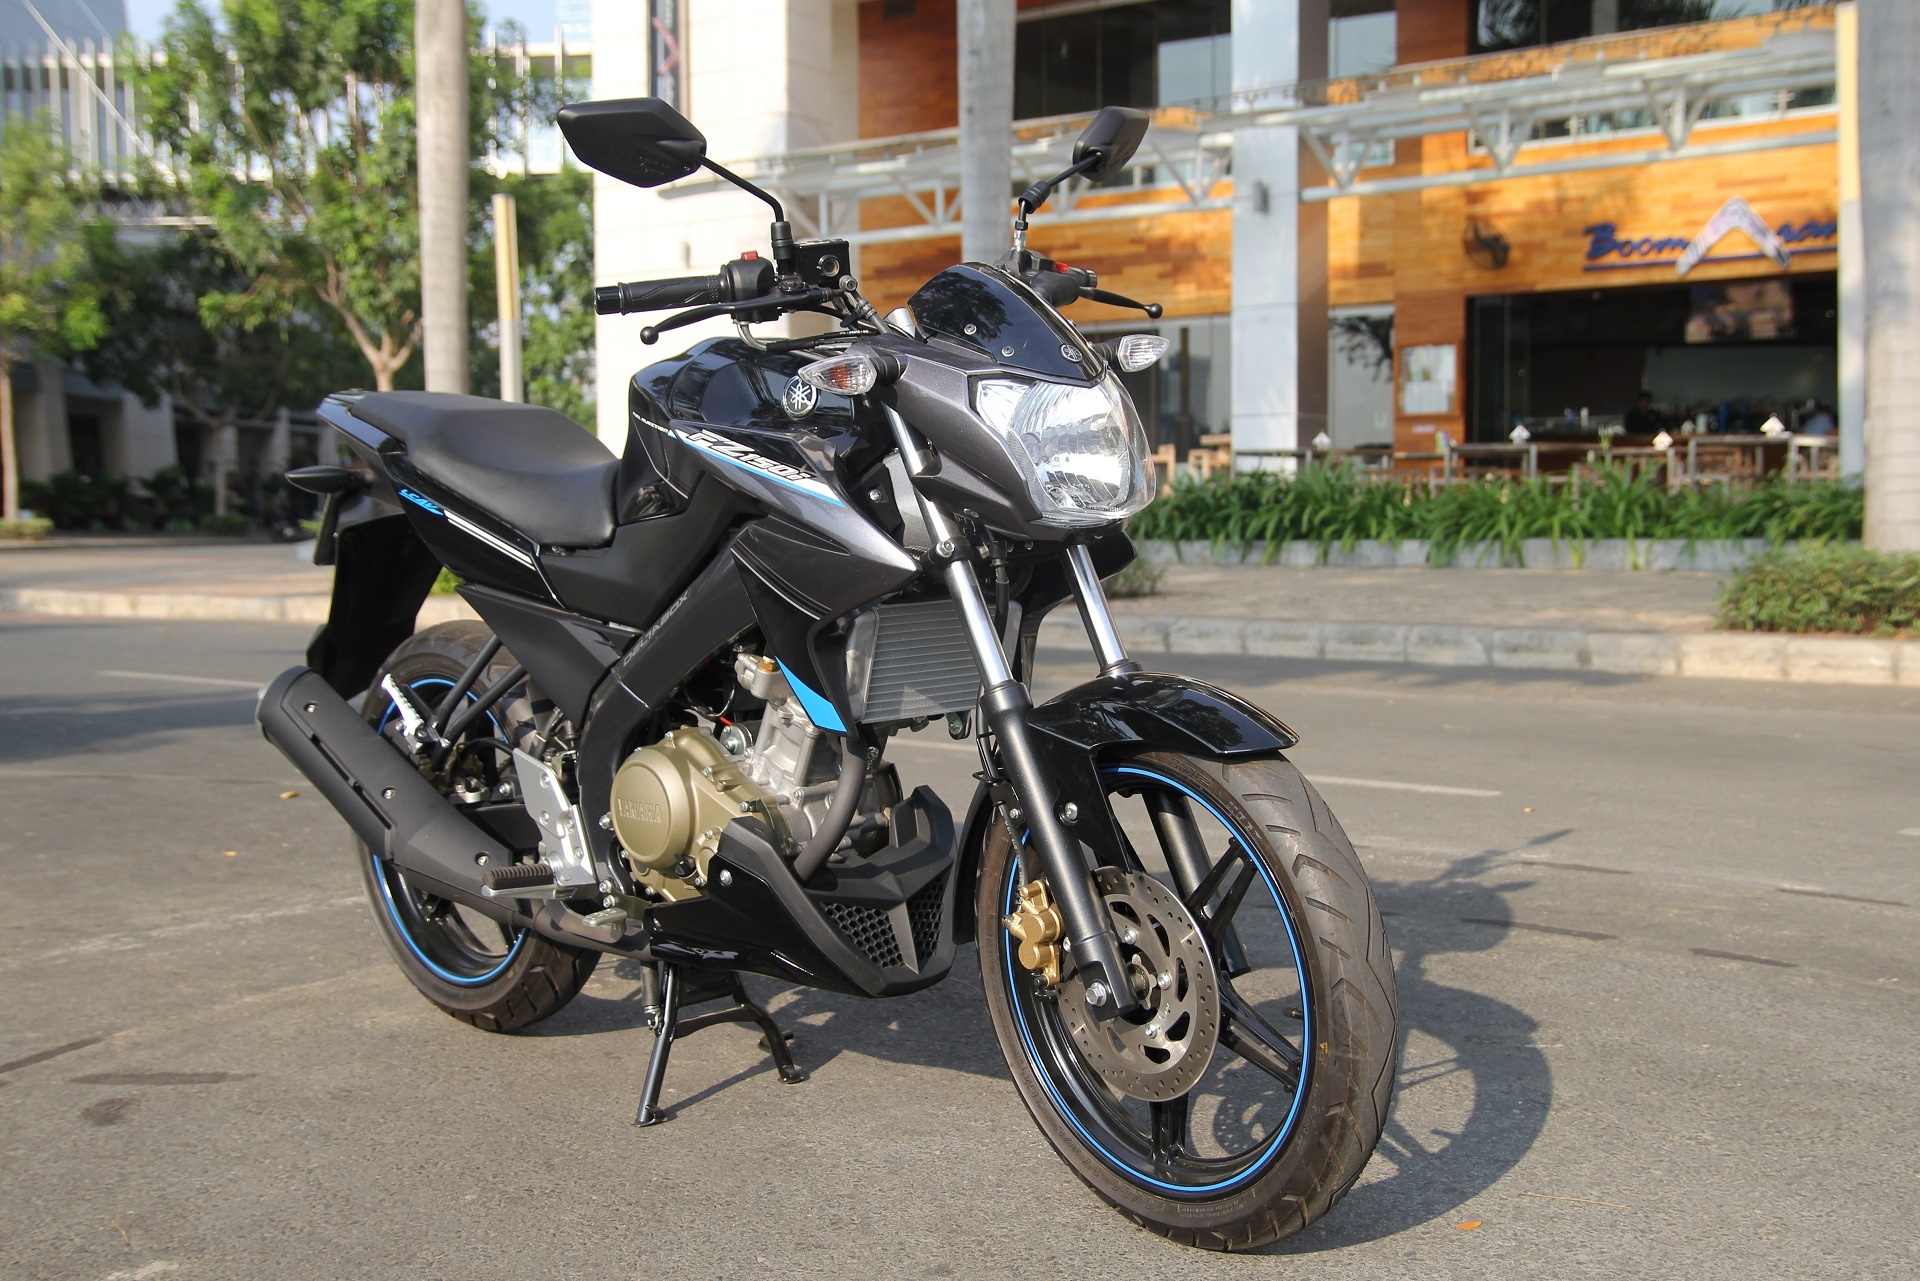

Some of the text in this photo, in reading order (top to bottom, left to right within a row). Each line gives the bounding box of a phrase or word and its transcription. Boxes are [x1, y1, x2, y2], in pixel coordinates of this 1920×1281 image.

[688, 429, 812, 481] FZ150i
[623, 588, 688, 667] DELTABOX
[617, 798, 662, 824] YAMAHA
